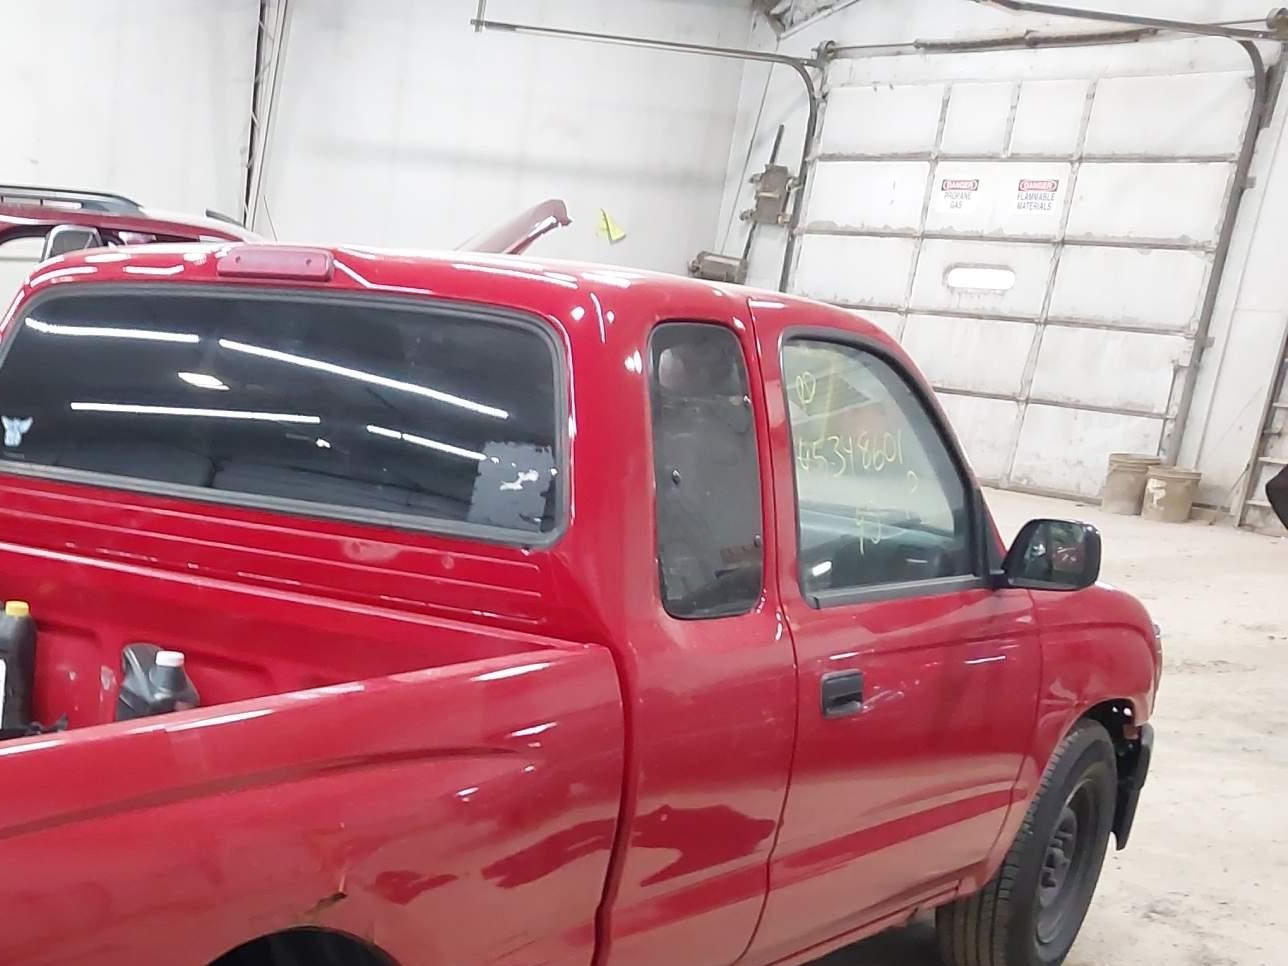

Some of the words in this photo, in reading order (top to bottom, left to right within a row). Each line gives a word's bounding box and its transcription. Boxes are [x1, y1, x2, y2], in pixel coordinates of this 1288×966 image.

[1022, 180, 1054, 191] DANGER
[943, 191, 972, 201] PROPANE
[1016, 192, 1056, 202] FLAMMABLE
[949, 200, 963, 210] GAS
[1016, 201, 1053, 211] MATERIALS
